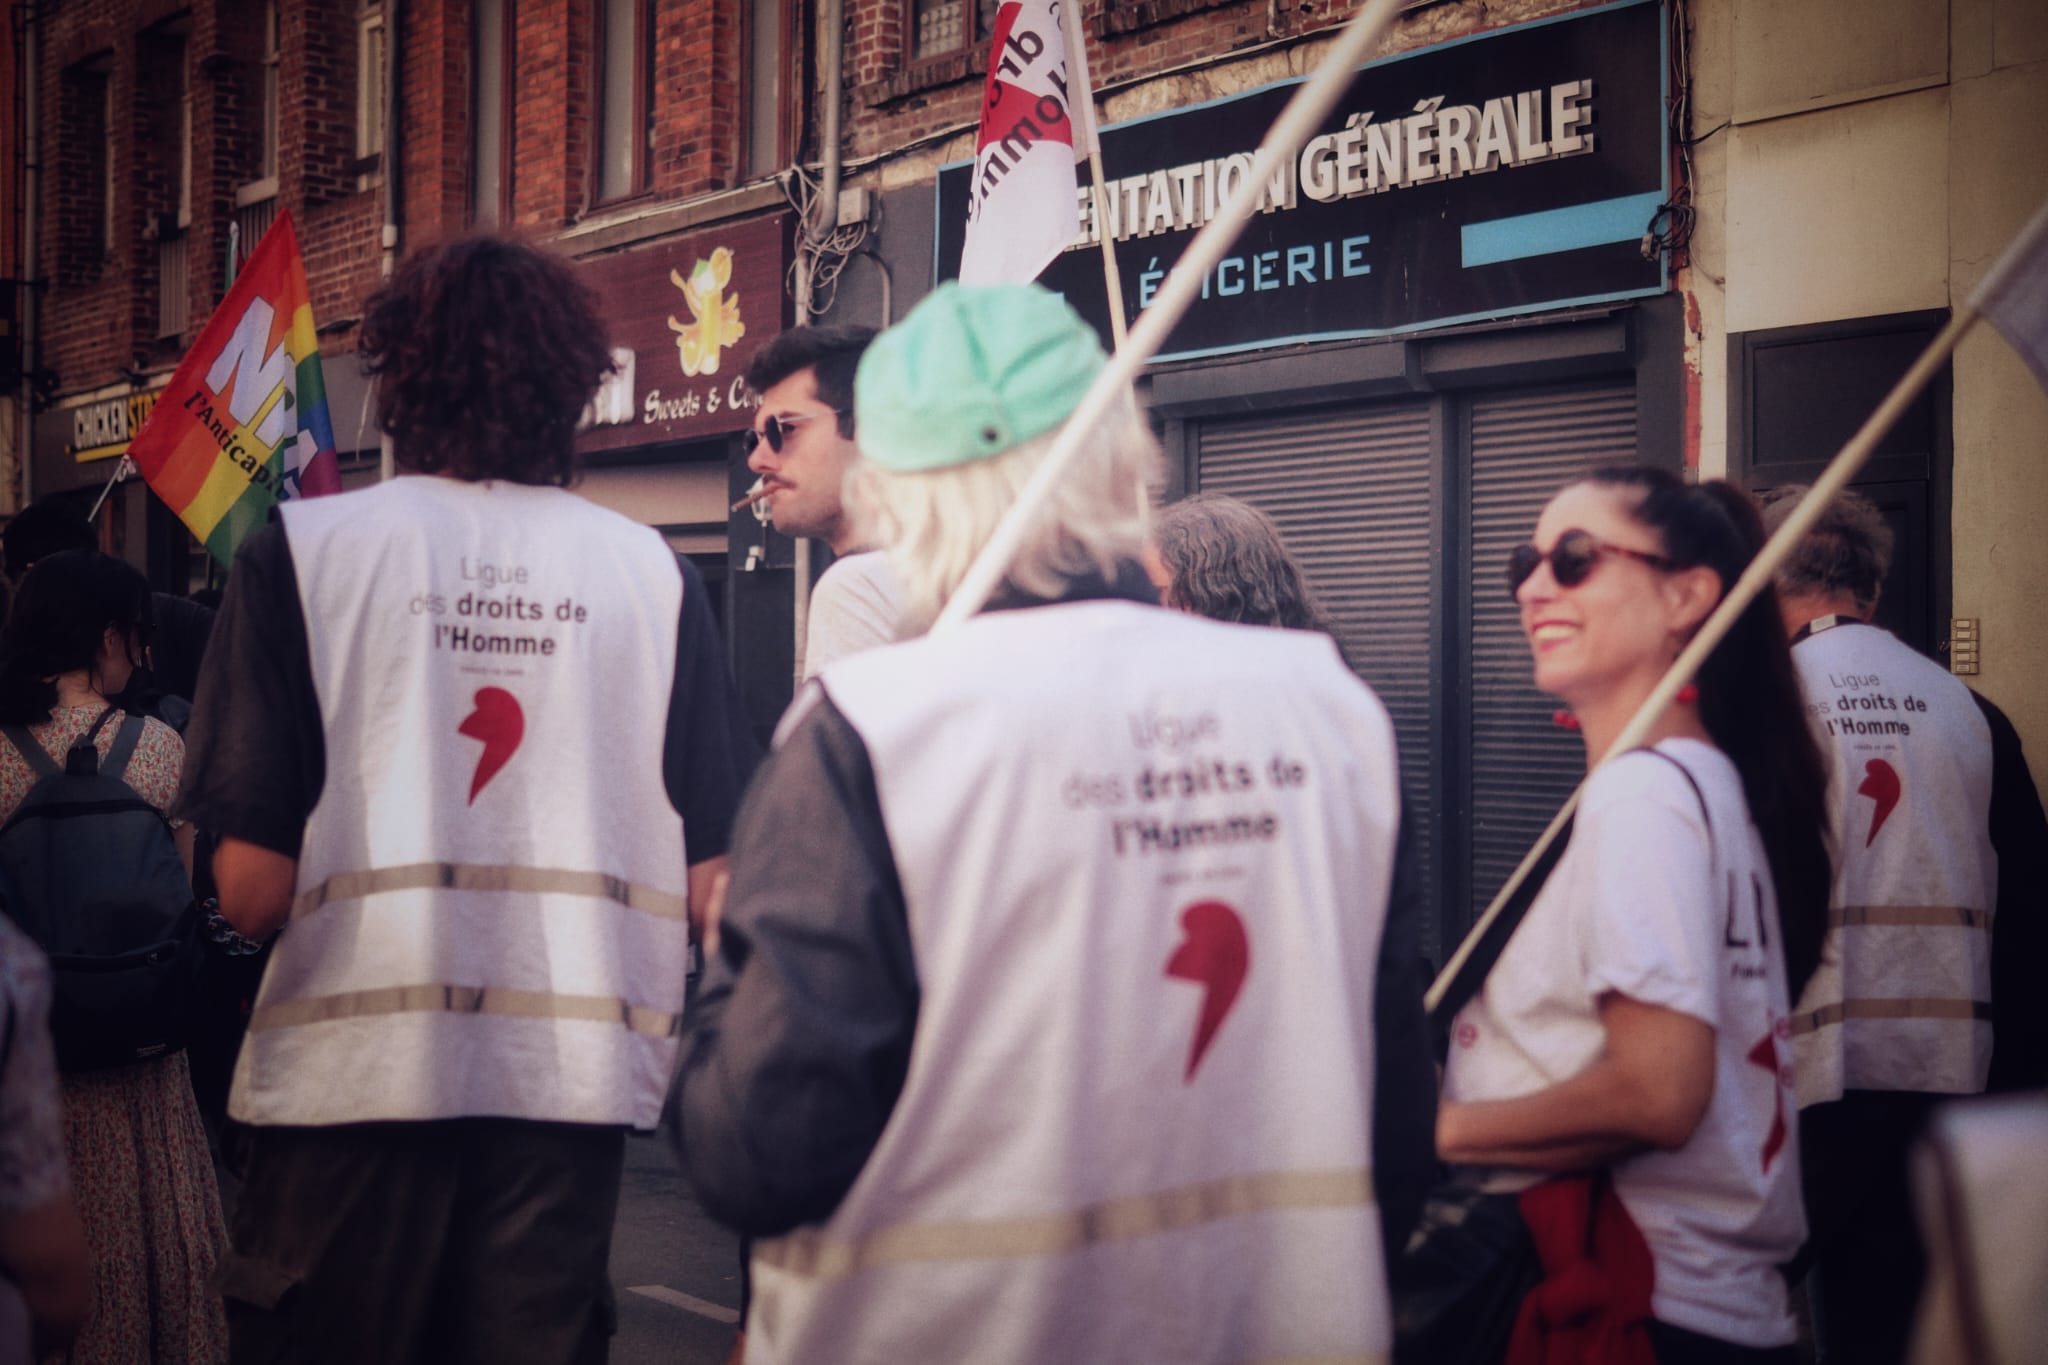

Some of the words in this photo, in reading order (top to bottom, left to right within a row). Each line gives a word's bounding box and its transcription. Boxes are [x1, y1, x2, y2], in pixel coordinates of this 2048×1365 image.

[1066, 148, 1297, 251] ENTATION
[1300, 79, 1594, 203] GÉNÉRALE
[1139, 234, 1371, 309] ÉICERIE
[643, 389, 700, 424] Sweets
[706, 386, 721, 413] &
[74, 398, 128, 450] CHICKEN
[460, 556, 529, 589] Ligue
[457, 591, 544, 621] droits
[555, 597, 588, 624] de
[434, 624, 556, 656] l'Homme
[1828, 673, 1881, 691] Ligue
[1807, 701, 1831, 716] es
[1837, 693, 1898, 711] droits
[1903, 695, 1928, 713] de
[1826, 717, 1911, 737] l'Homme
[1134, 759, 1254, 803] droits
